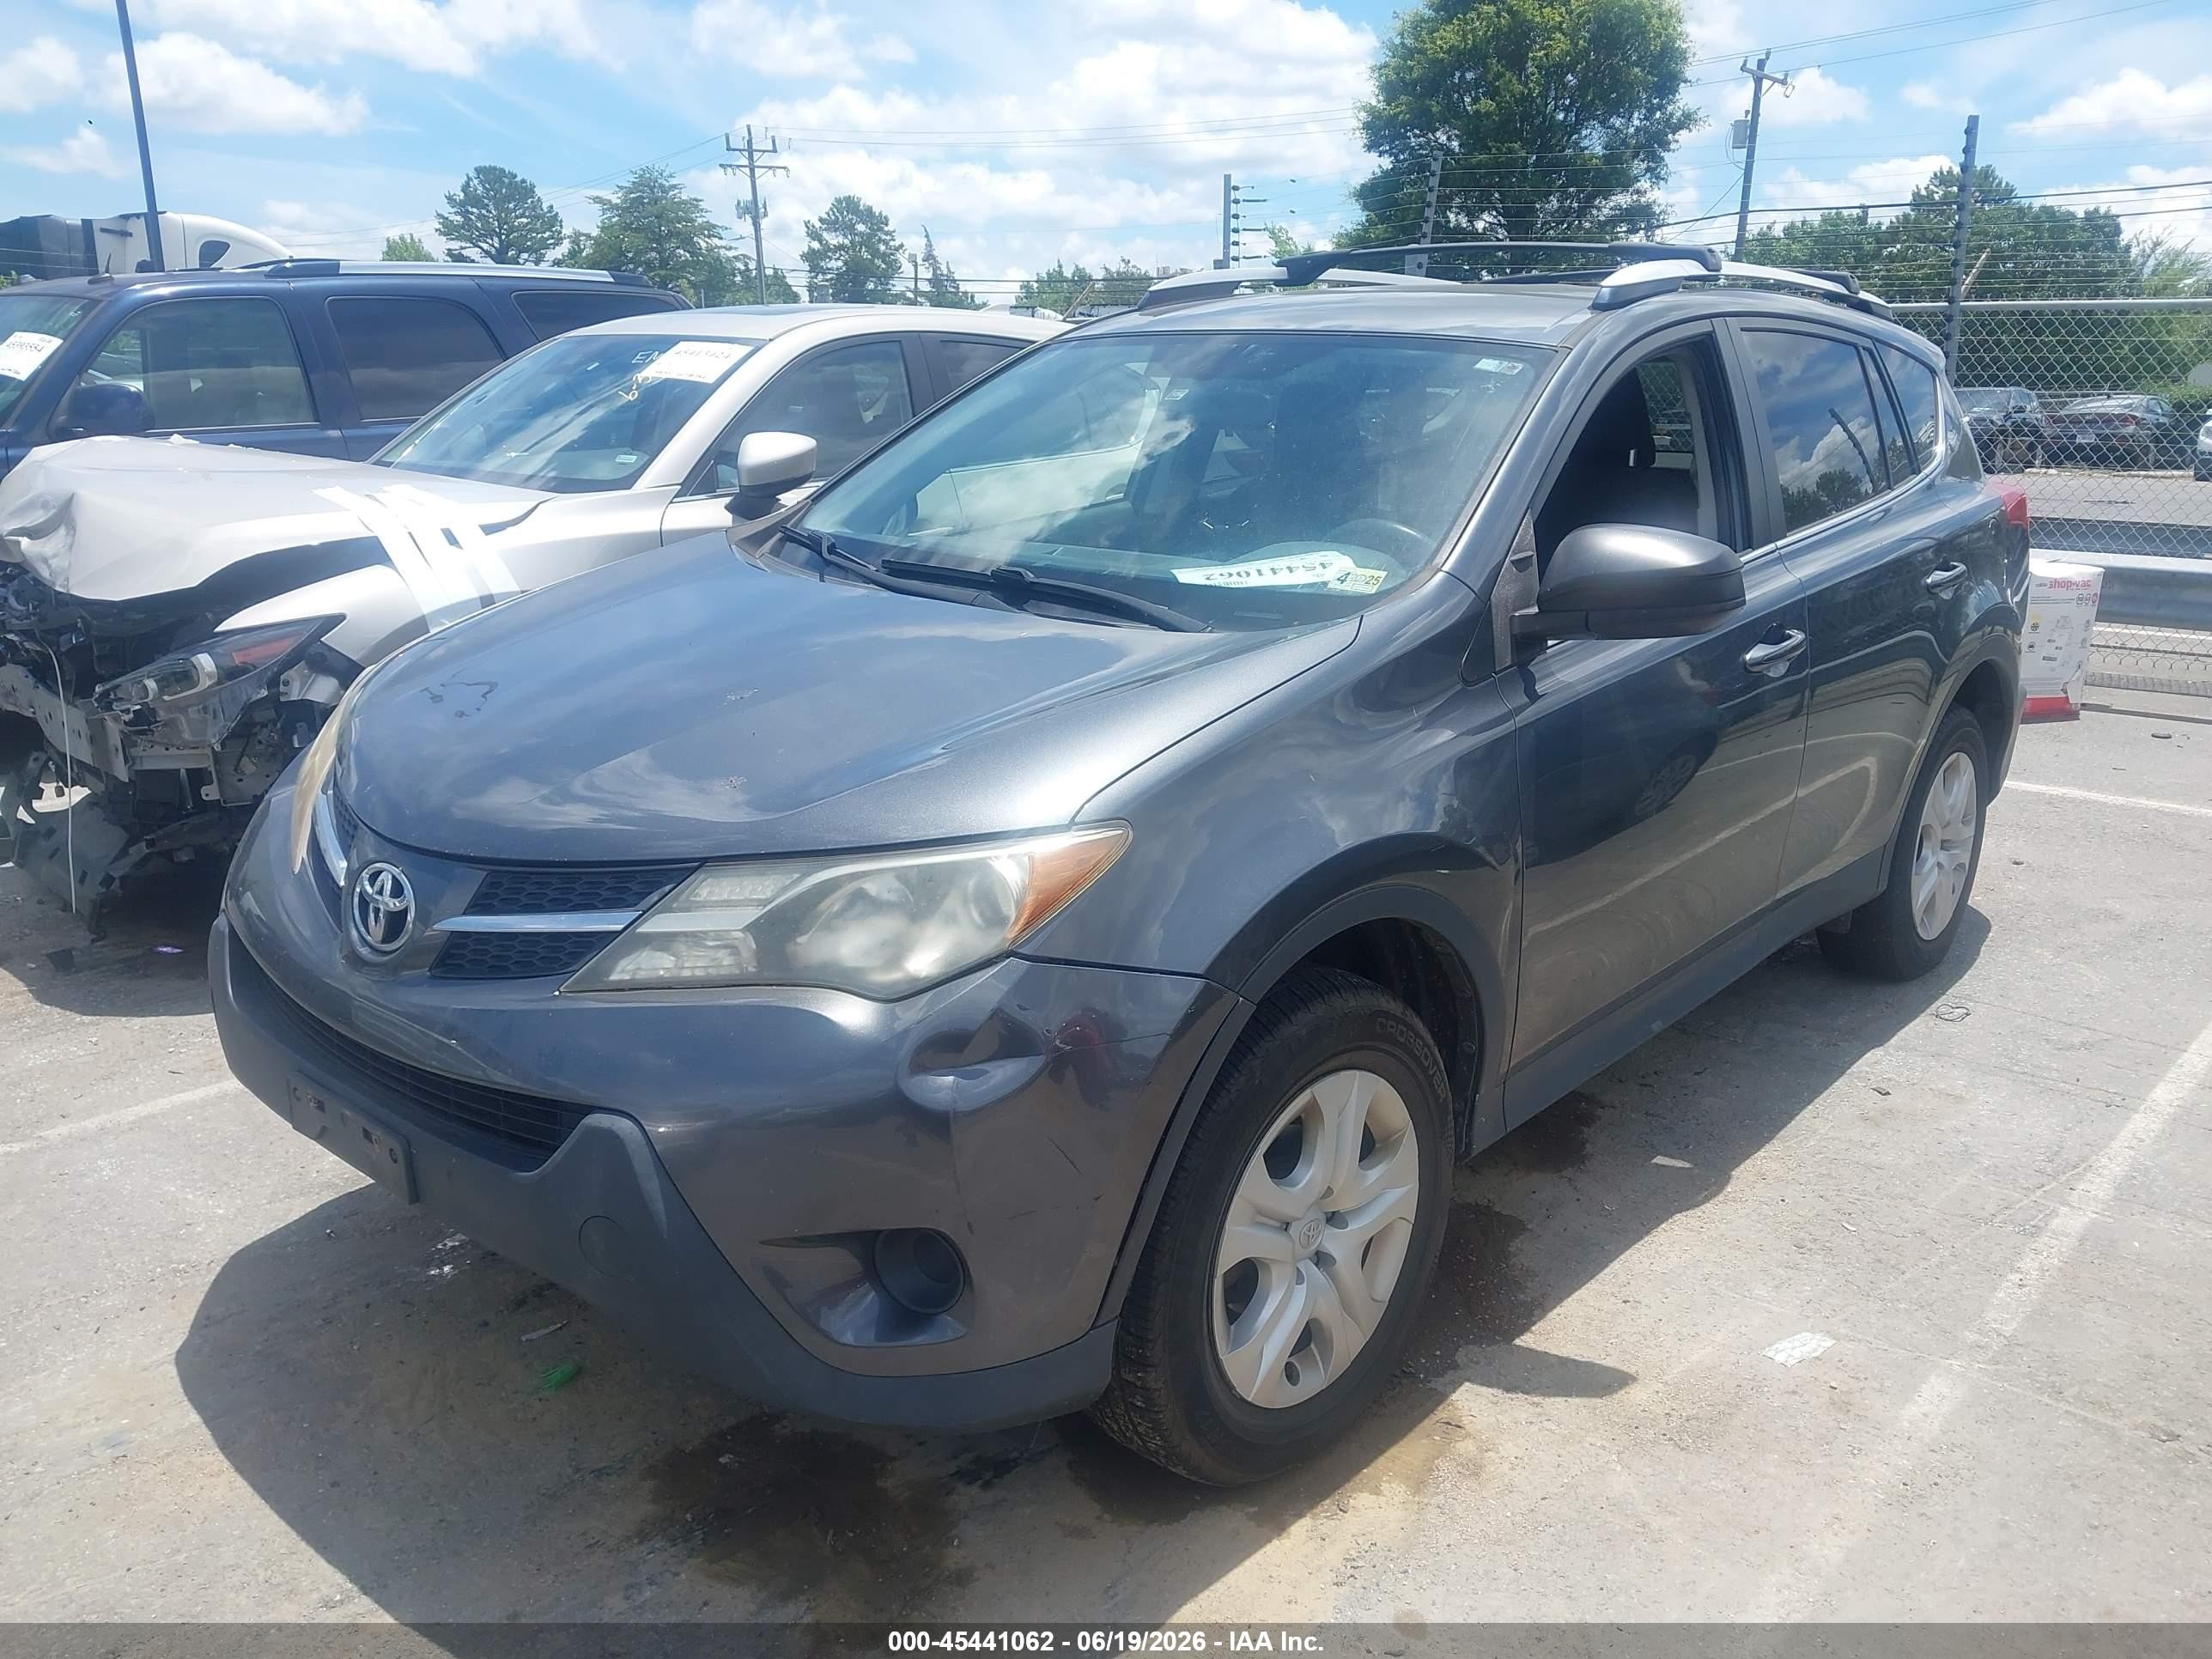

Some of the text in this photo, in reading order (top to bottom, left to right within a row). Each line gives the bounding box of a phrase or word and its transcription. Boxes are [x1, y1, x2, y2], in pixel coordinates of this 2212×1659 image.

[1204, 562, 1334, 581] 45441062
[1364, 574, 1382, 586] 25
[1376, 1018, 1447, 1103] CROSSOVER
